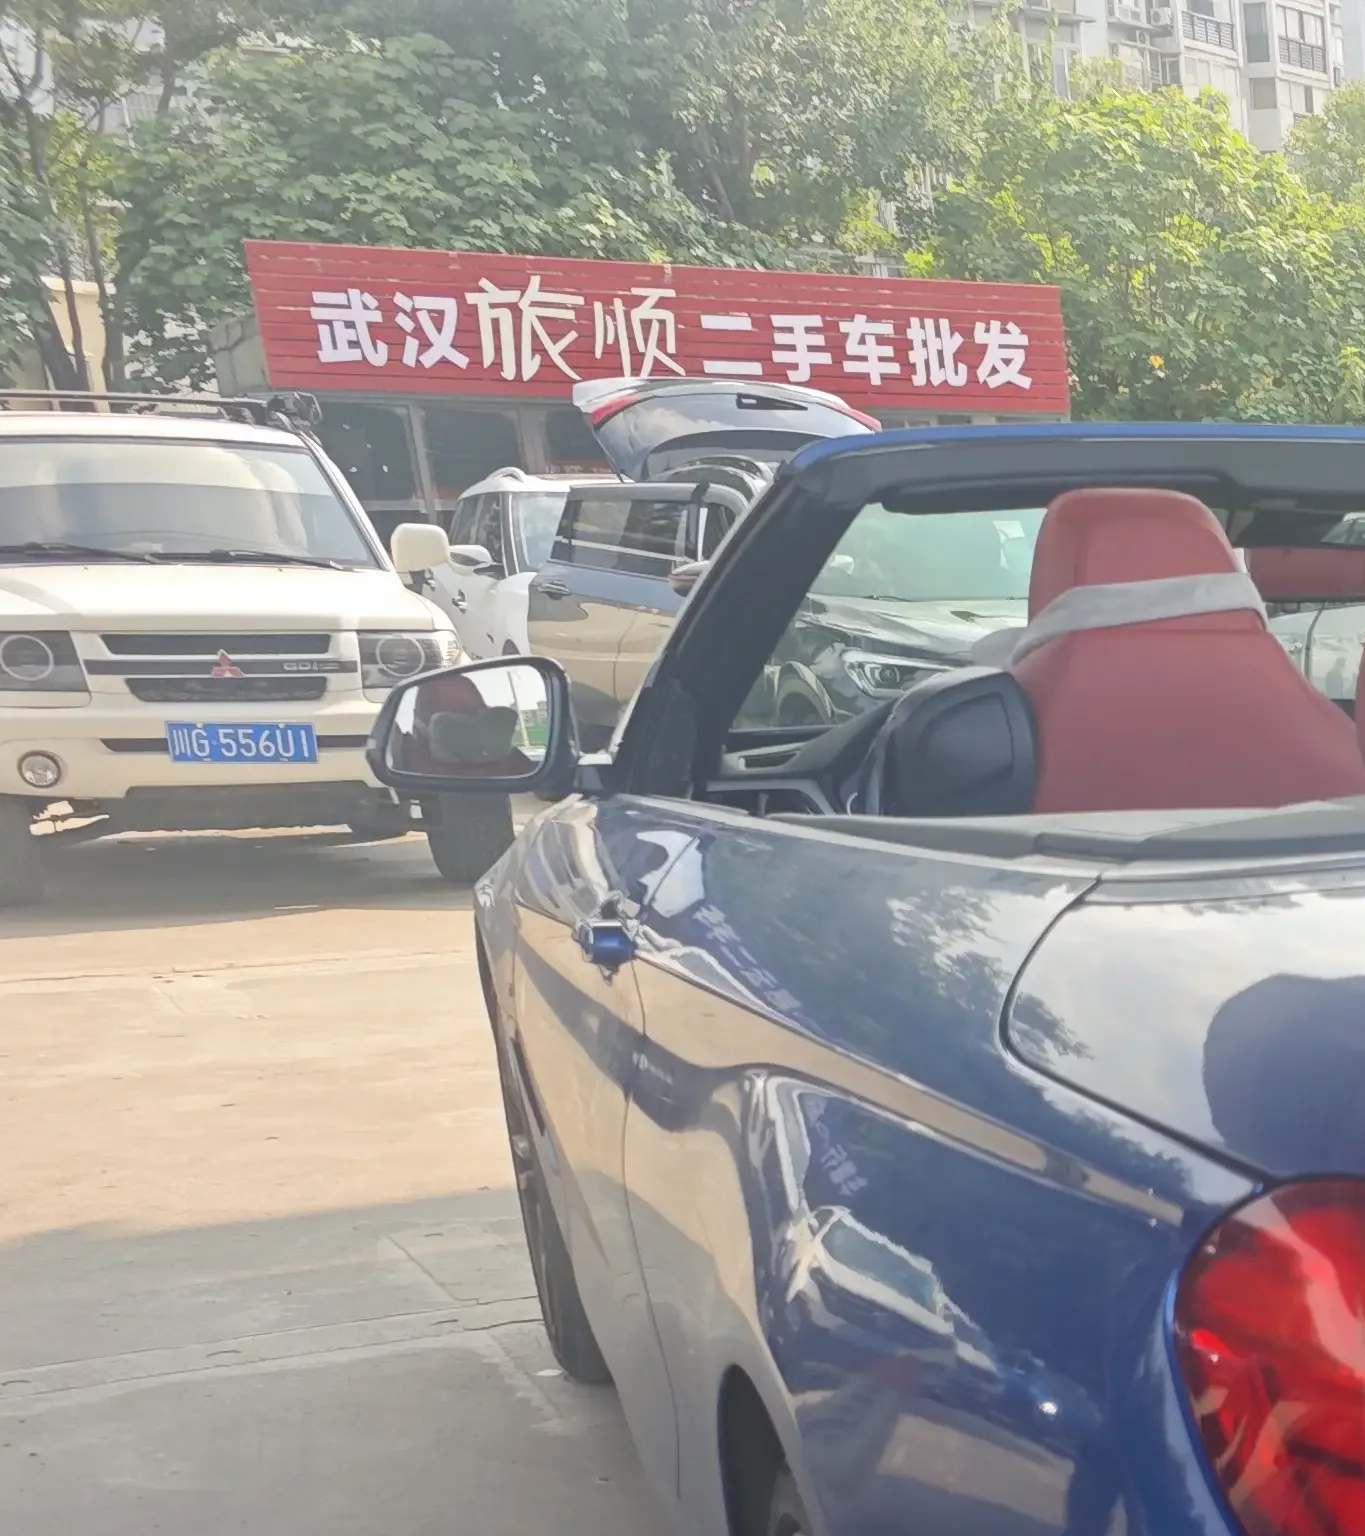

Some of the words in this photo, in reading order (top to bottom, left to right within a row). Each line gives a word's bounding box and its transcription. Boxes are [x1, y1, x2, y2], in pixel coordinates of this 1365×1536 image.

[309, 275, 1032, 390] 武汉旅顺二手车批发
